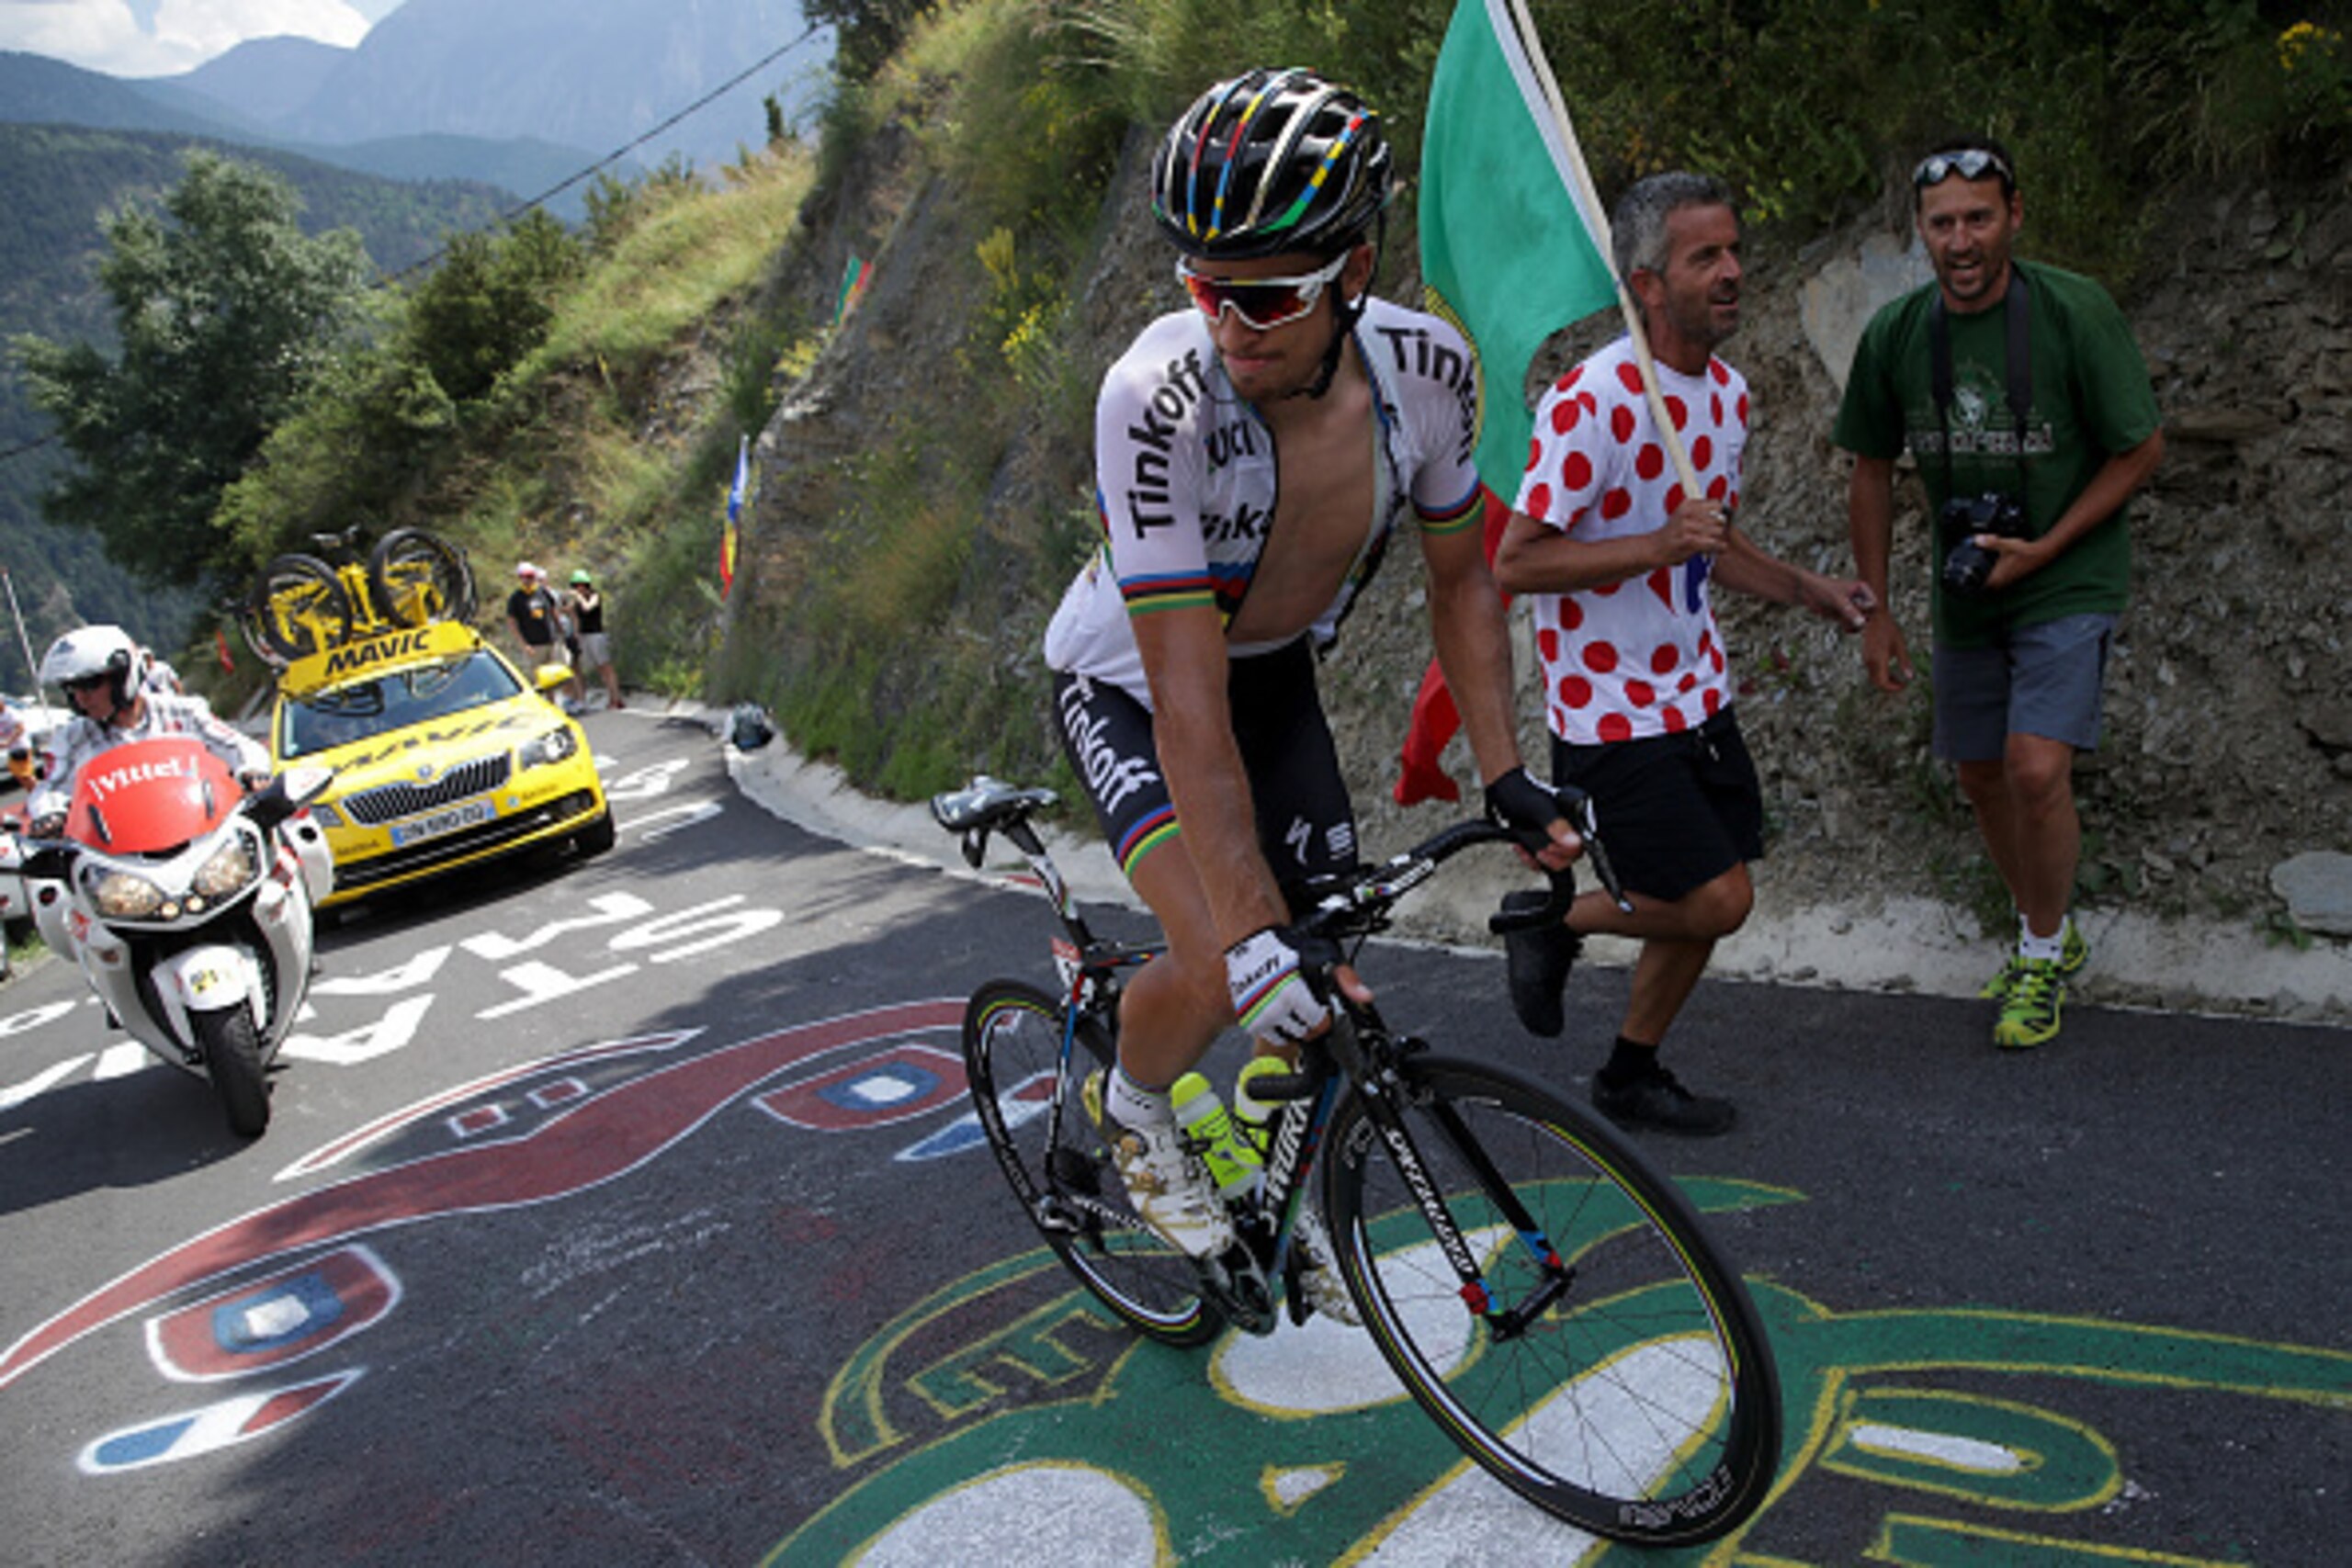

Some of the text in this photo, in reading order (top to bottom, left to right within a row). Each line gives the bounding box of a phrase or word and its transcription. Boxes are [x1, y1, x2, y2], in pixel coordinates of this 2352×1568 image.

[1127, 347, 1207, 539] Tinkoff
[1208, 419, 1256, 468] UCI
[1374, 325, 1476, 468] Tink
[325, 629, 432, 675] MAVIC
